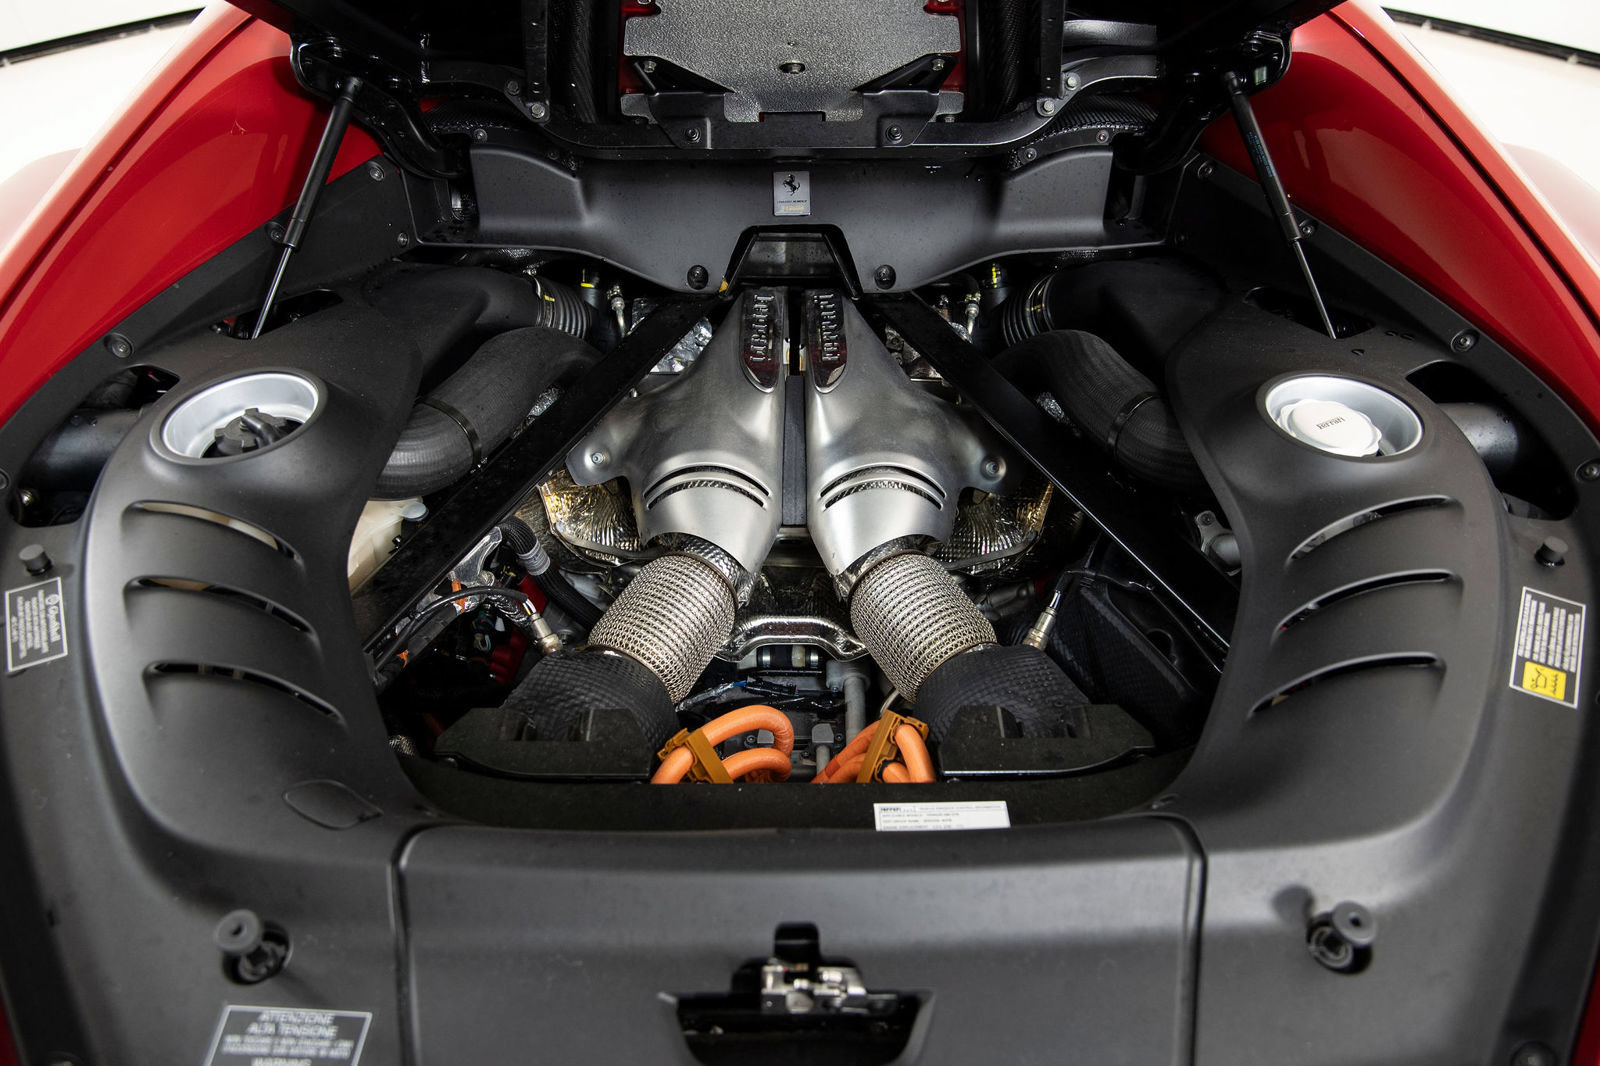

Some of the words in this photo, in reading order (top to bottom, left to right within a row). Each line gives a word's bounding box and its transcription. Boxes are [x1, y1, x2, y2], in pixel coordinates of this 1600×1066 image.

[257, 1010, 335, 1025] ATTENZIONE
[246, 1022, 276, 1035] ALTA
[277, 1023, 339, 1039] TENSIONE
